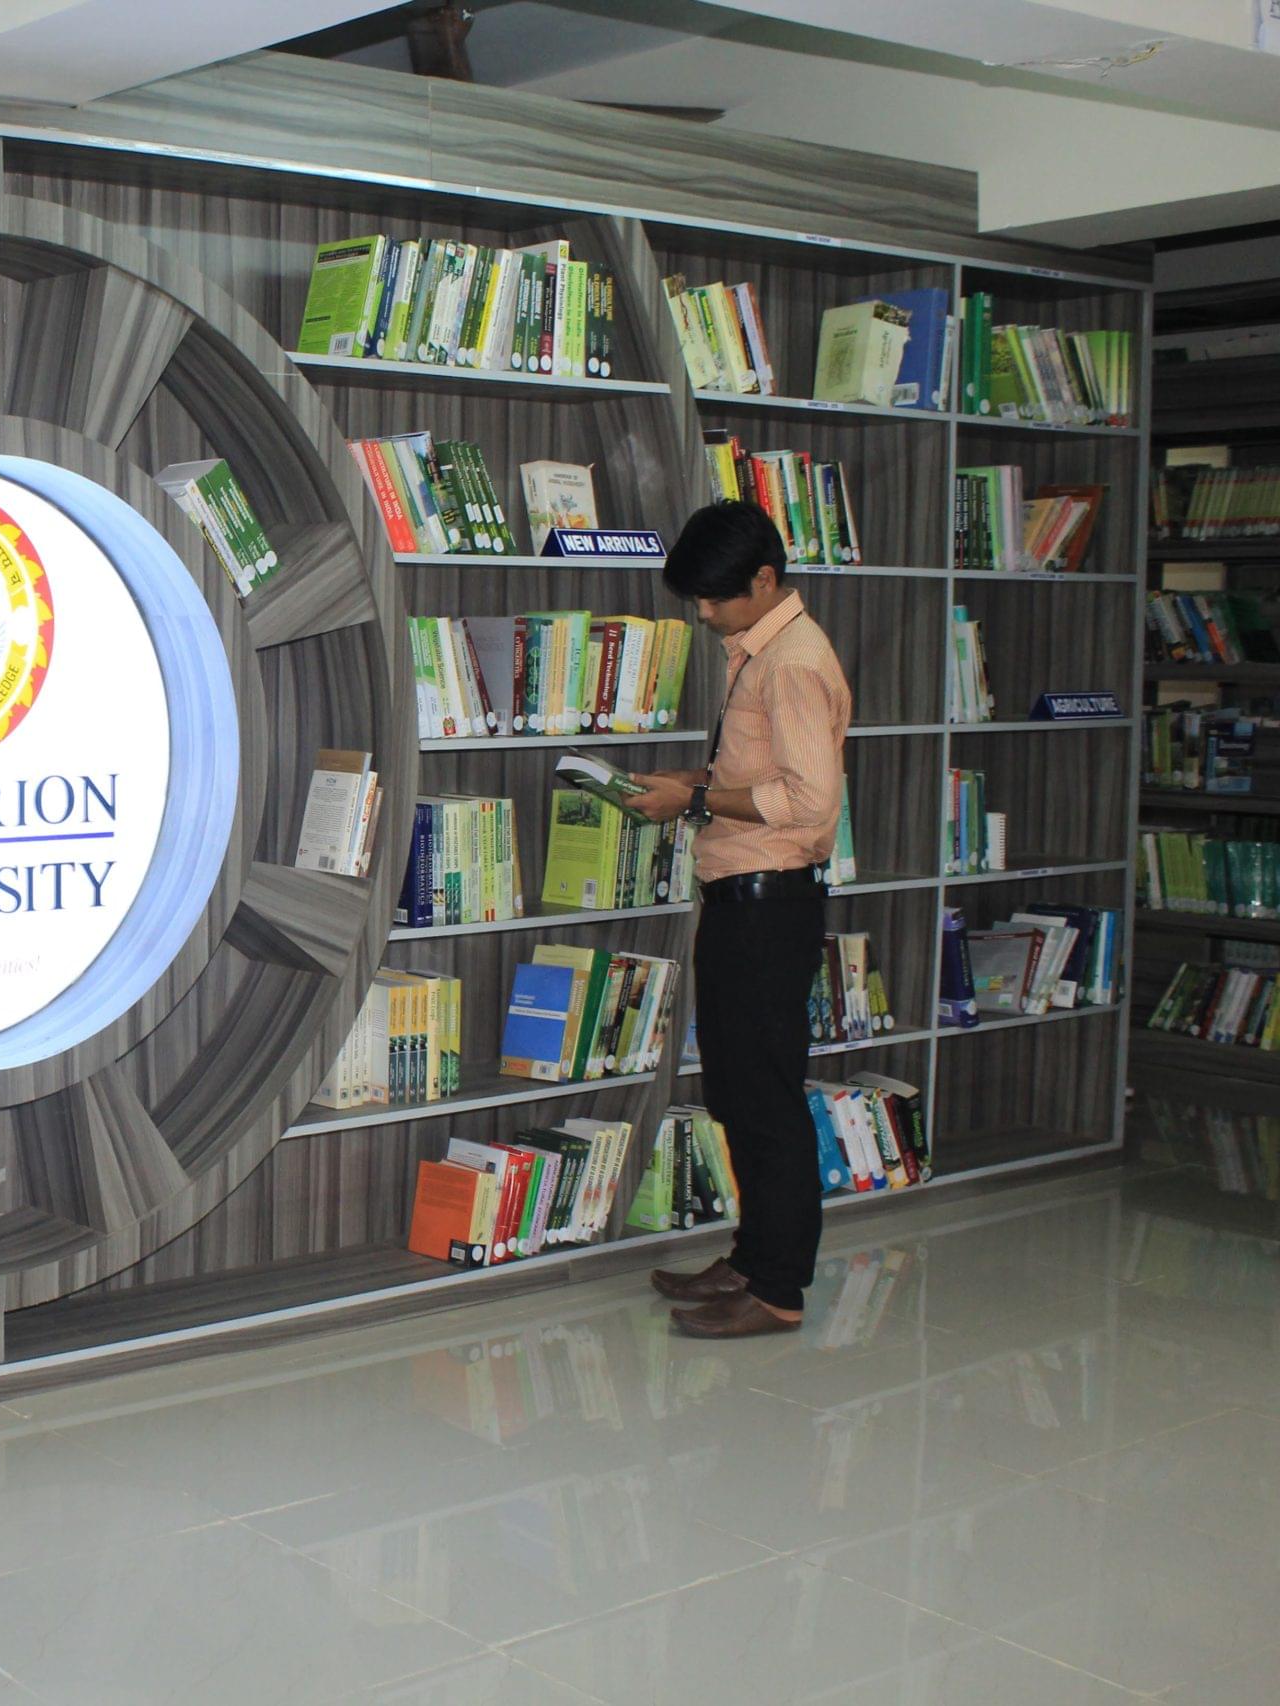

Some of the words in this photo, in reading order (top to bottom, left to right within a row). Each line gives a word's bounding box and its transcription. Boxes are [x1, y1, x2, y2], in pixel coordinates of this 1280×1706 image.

[562, 534, 595, 552] NEW
[596, 535, 660, 553] ARRIVALS
[1051, 697, 1119, 714] AGRICULTURE
